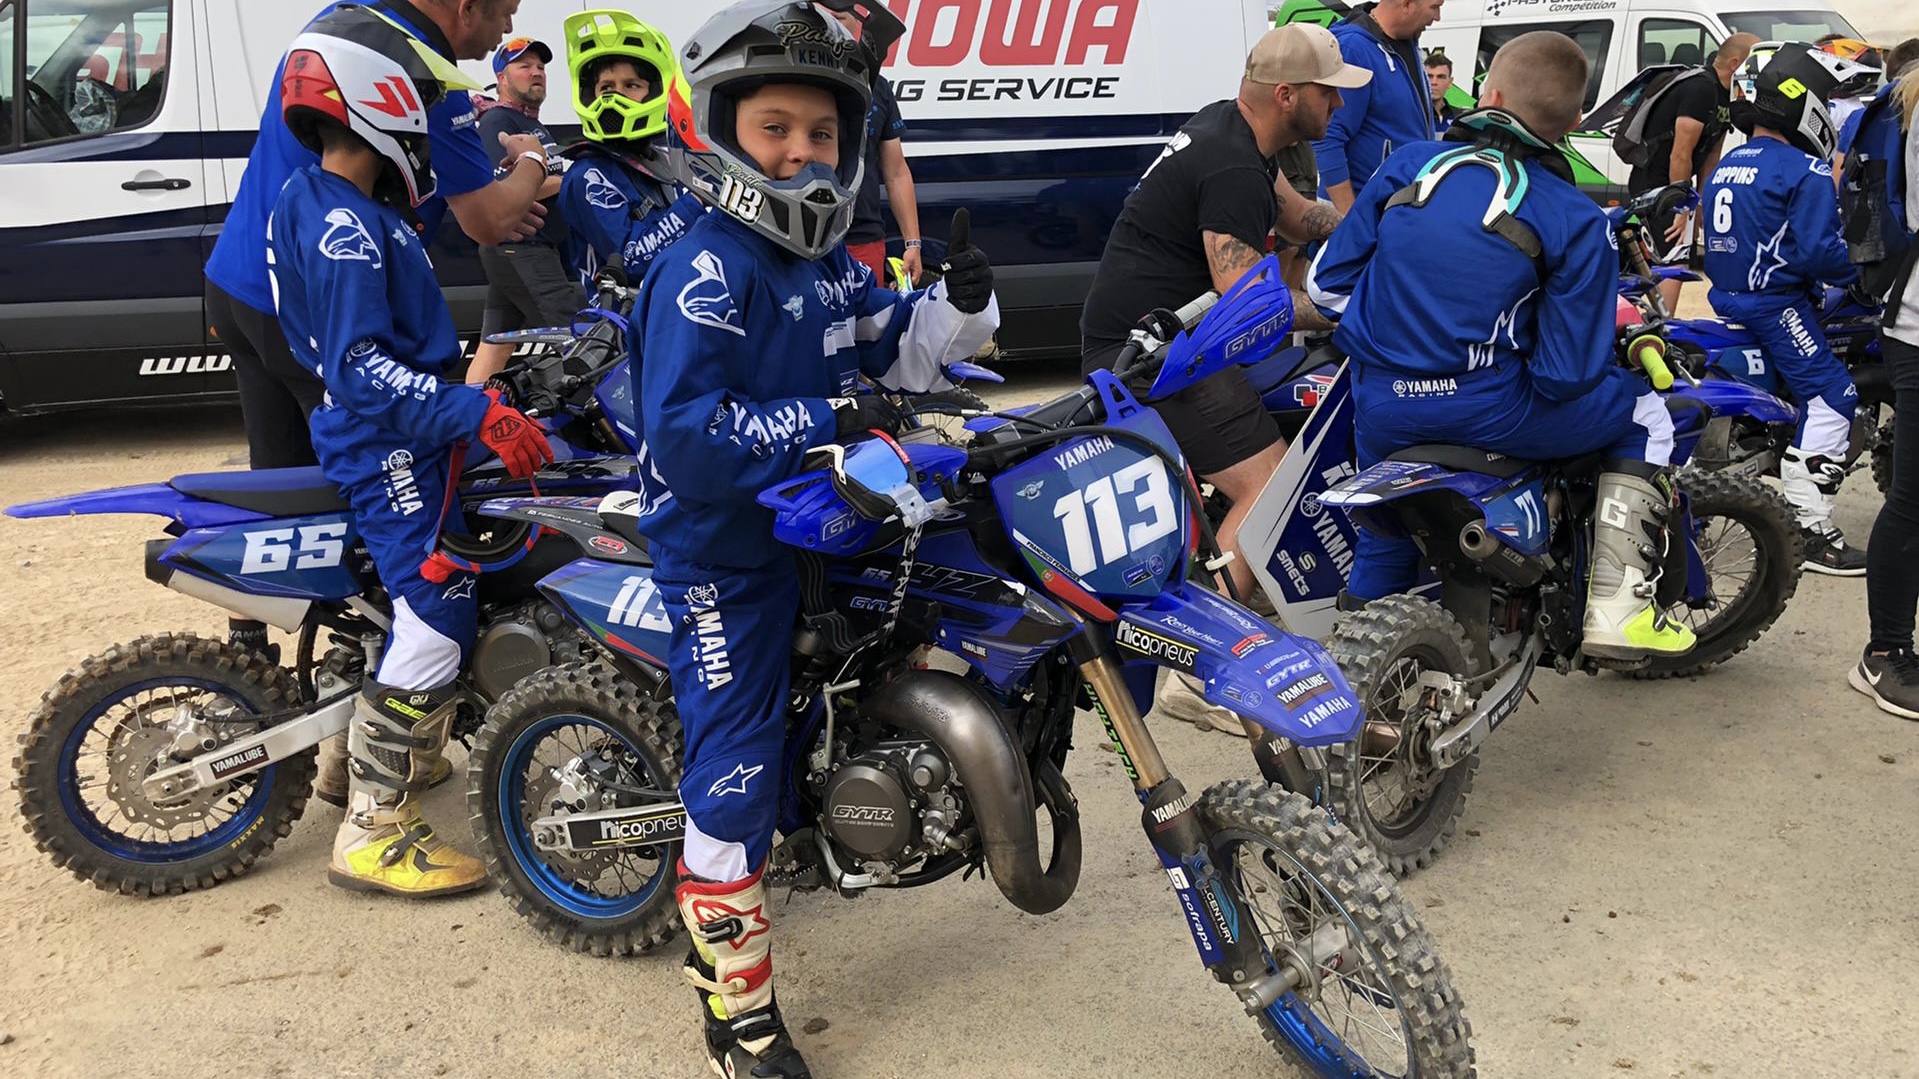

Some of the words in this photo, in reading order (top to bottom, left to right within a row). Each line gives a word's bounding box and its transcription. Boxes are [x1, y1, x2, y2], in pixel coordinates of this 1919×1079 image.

[881, 0, 1140, 67] OWA
[937, 77, 1120, 101] SERVICE
[1712, 166, 1759, 185] COPPINS
[720, 174, 764, 223] 113
[1713, 187, 1734, 234] 6
[1742, 349, 1766, 375] 6
[1406, 378, 1457, 393] YAMAHA
[1054, 435, 1115, 471] YAMAHA
[1053, 454, 1178, 577] 113
[240, 522, 348, 574] 65
[1277, 673, 1328, 703] YAMALUBE
[1299, 696, 1353, 729] YAMAHA
[212, 746, 265, 773] YAMALUBE
[832, 794, 895, 821] GYTR
[1182, 893, 1213, 951] sofrapa
